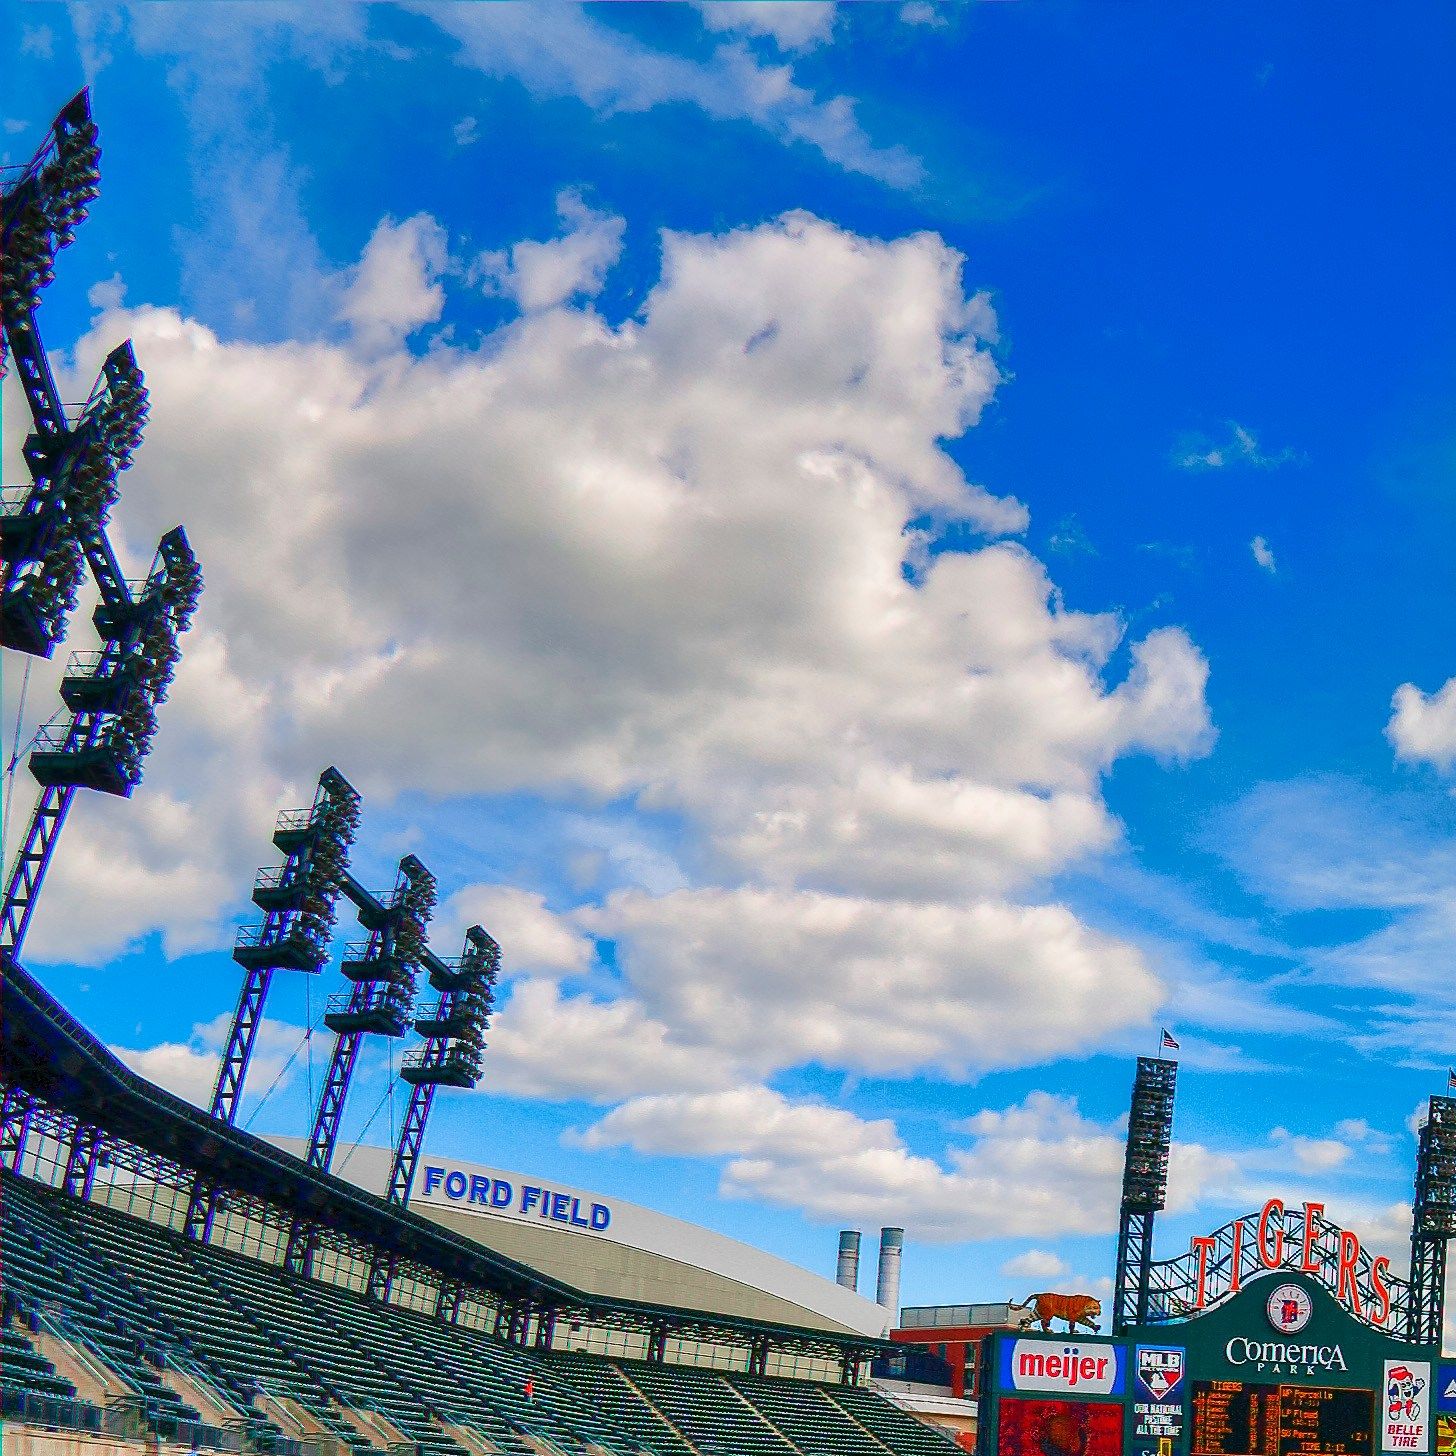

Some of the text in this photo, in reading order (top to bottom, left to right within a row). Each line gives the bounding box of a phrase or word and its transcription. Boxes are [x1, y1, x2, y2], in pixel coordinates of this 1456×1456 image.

[422, 1166, 613, 1231] FORD FIELD
[1190, 1198, 1390, 1325] TIGERS
[1018, 1347, 1109, 1387] meijer
[1141, 1352, 1180, 1368] MLB
[1256, 1362, 1316, 1376] PARK
[1387, 1424, 1423, 1436] BELLE
[1392, 1436, 1418, 1448] TIRE
